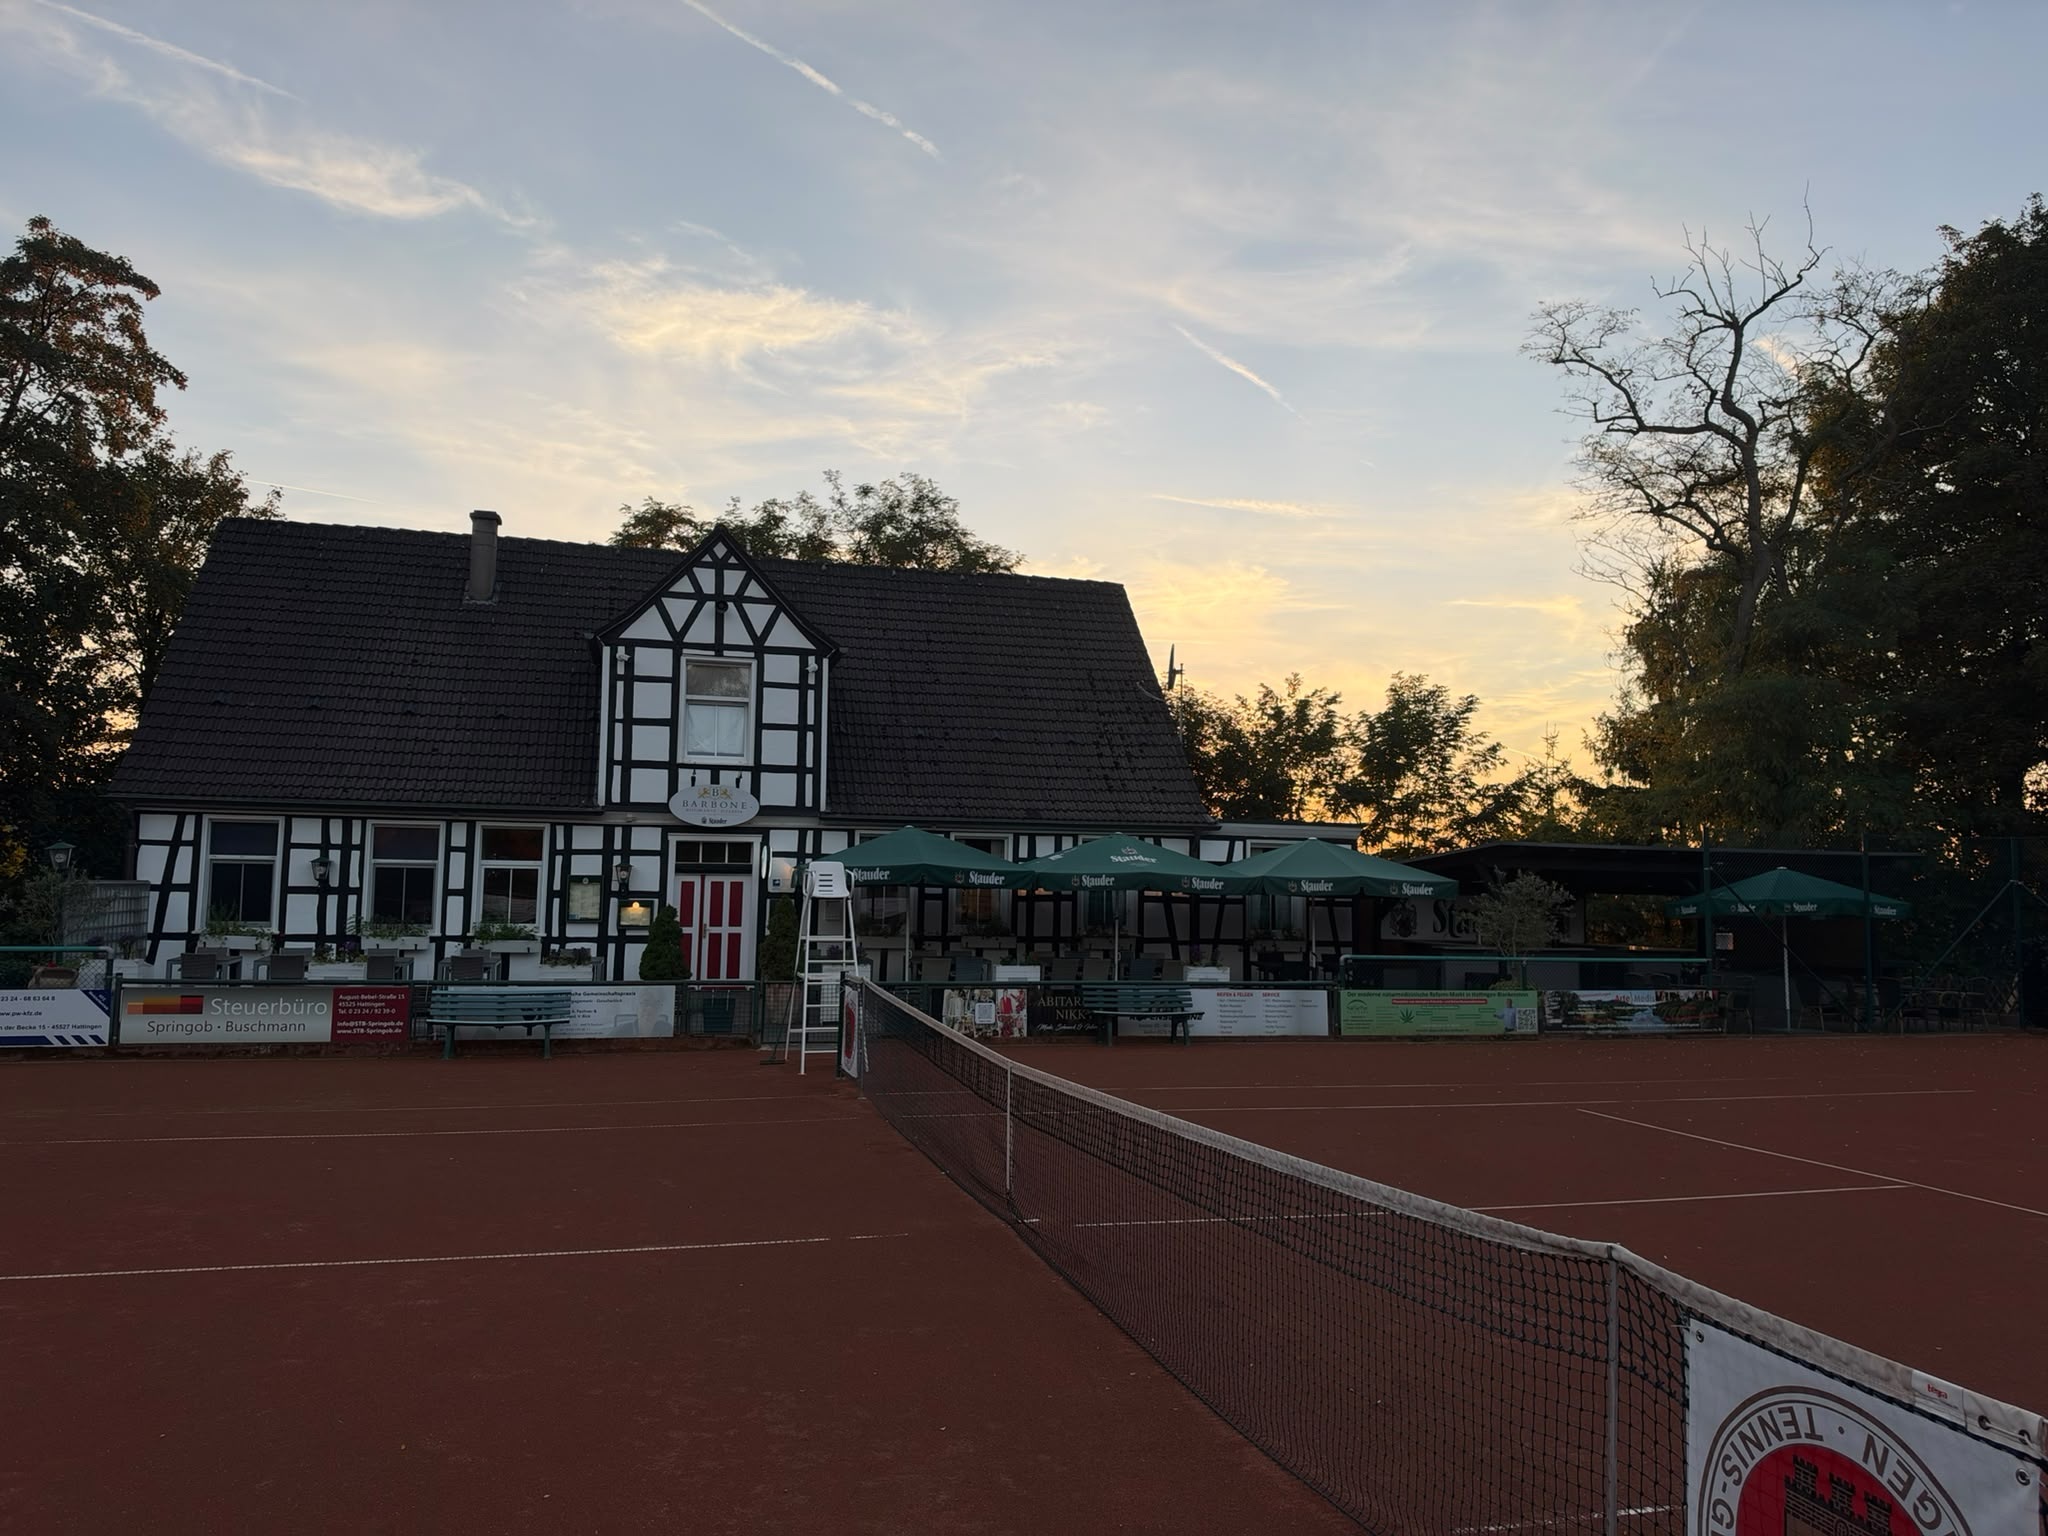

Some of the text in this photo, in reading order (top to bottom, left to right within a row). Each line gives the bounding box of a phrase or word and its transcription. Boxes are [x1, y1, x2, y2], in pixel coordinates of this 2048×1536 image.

[682, 799, 748, 809] BARBONE
[1109, 854, 1160, 864] Stauder
[852, 867, 891, 882] Stauder
[968, 870, 1006, 885] Stauder
[1081, 874, 1116, 888] Stauder
[1191, 876, 1225, 891] Stauder
[1300, 879, 1334, 894] Stauder
[1401, 882, 1435, 897] Stauder
[210, 998, 328, 1016] Steuerbüro
[357, 1001, 386, 1009] Hattingen
[71, 1023, 102, 1031] Hattingen
[147, 1020, 306, 1035] Springob Buschmann
[1711, 1406, 1824, 1536] TENNIS-G
